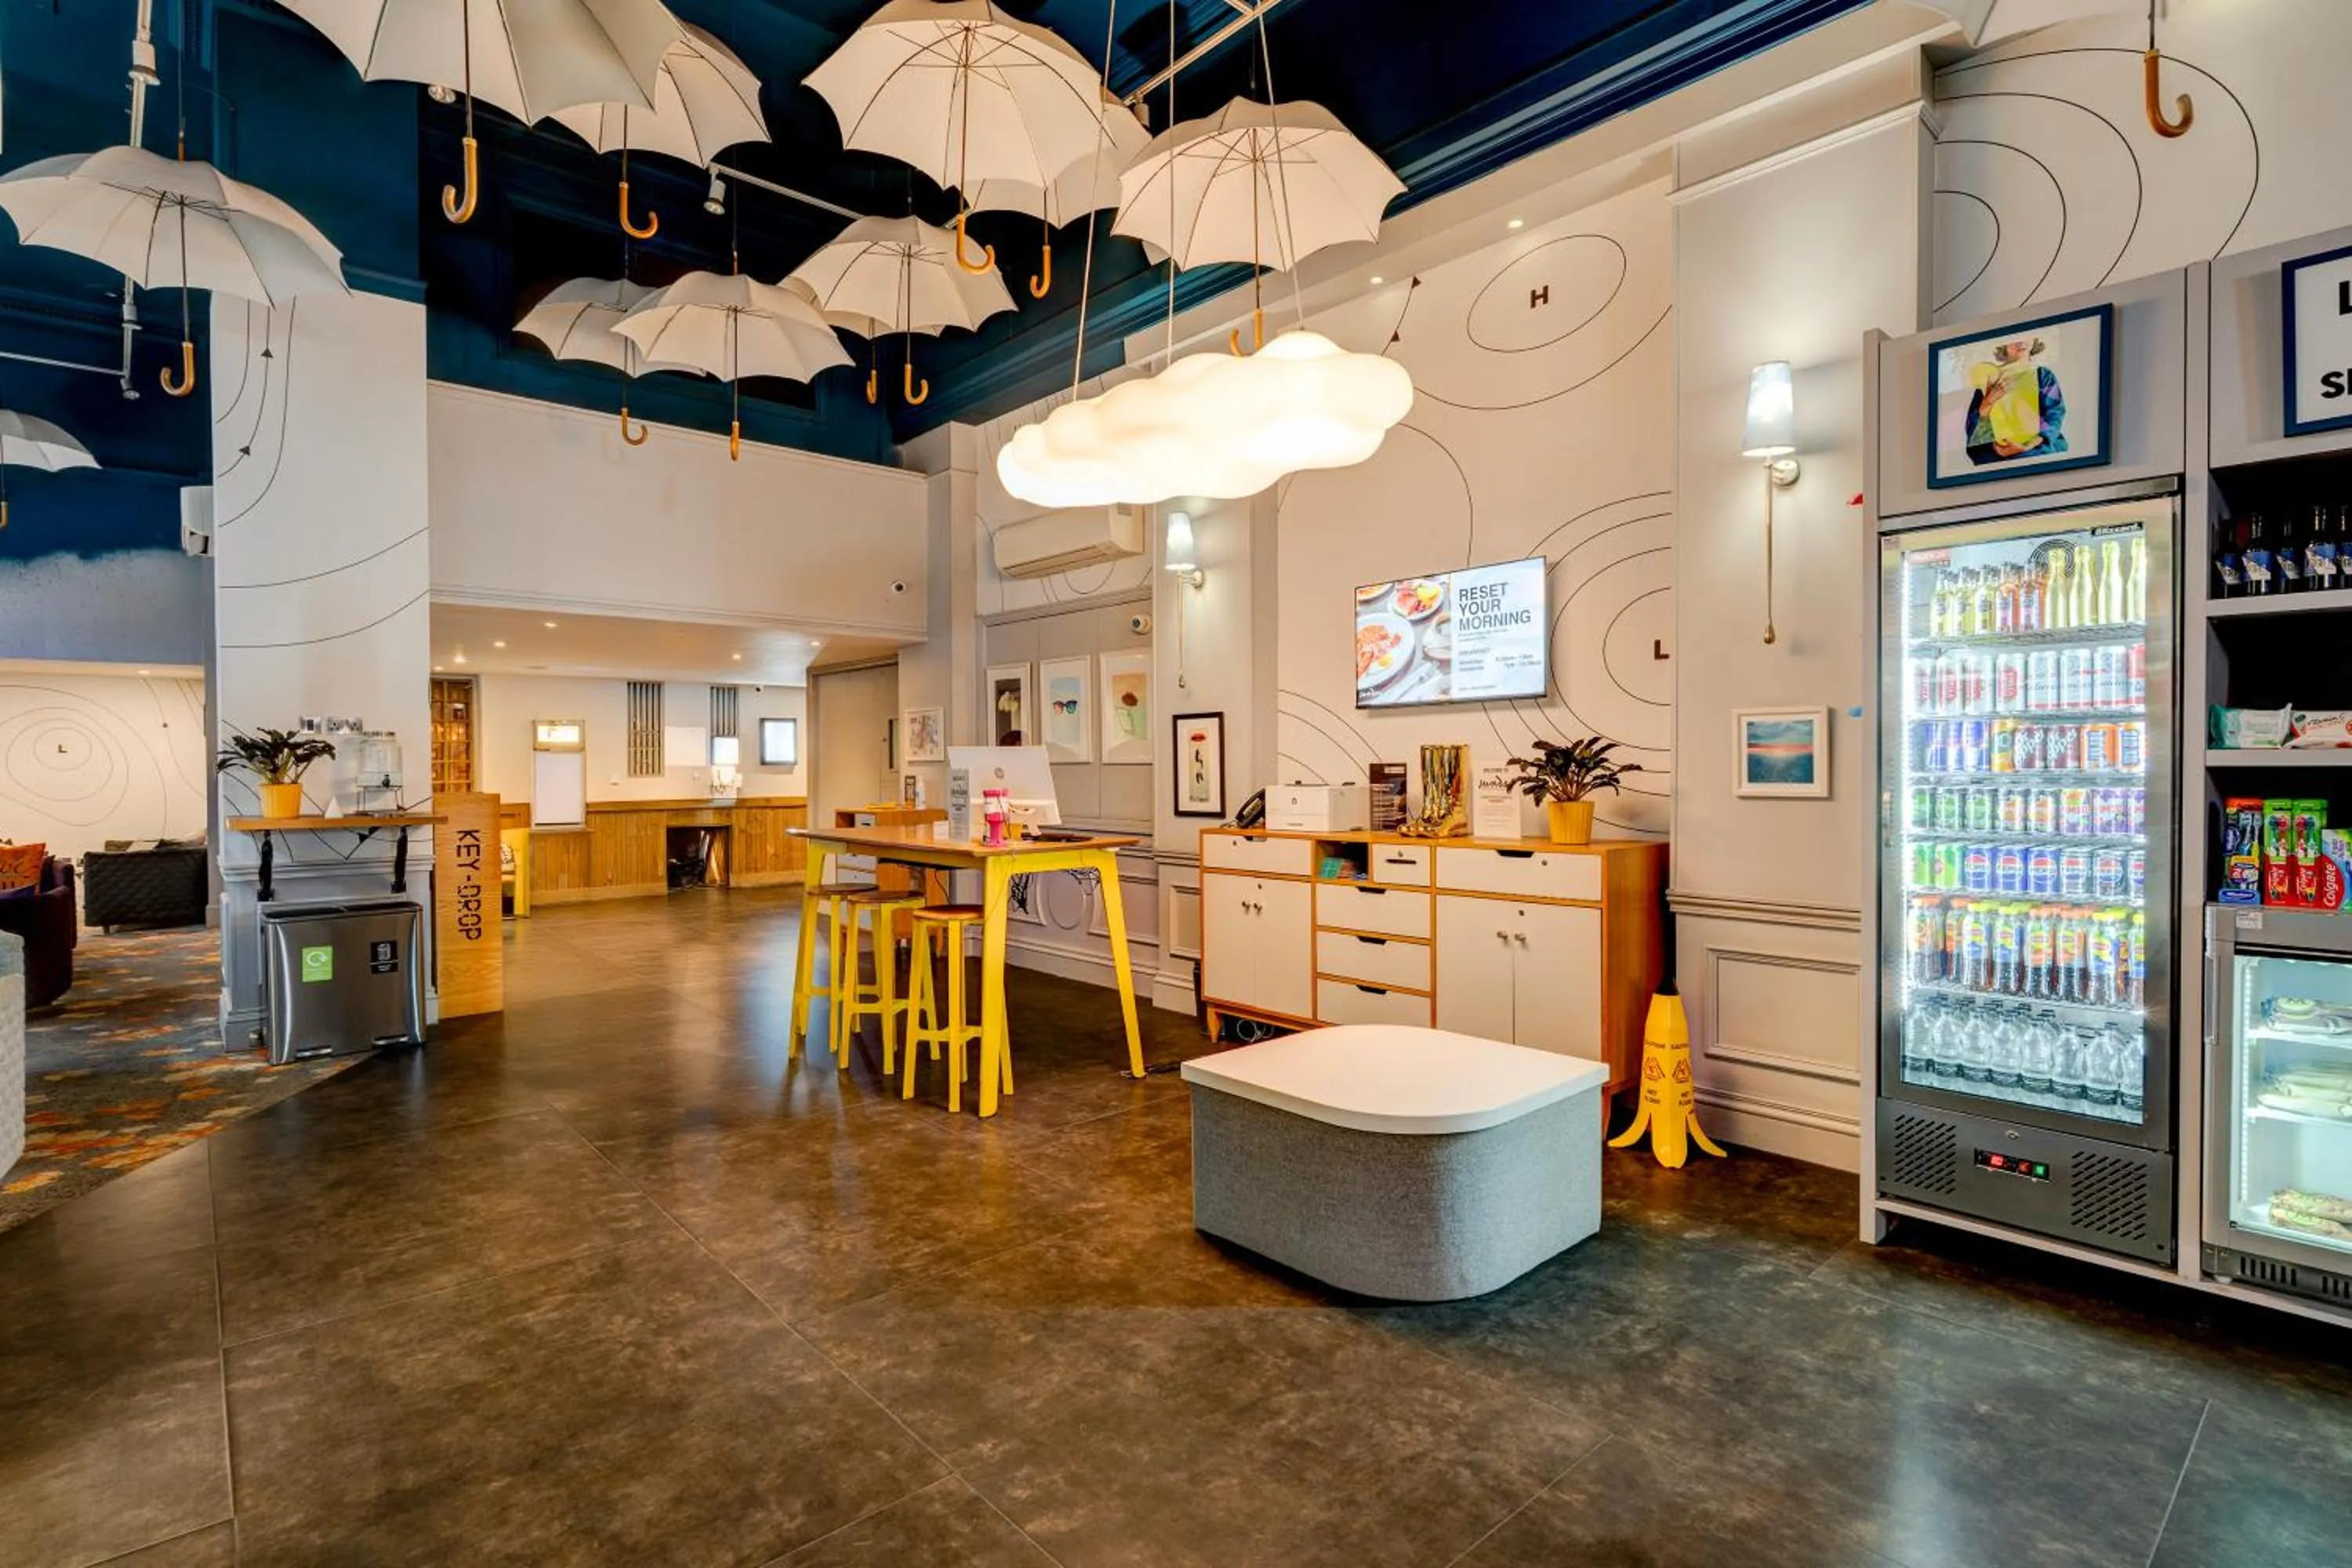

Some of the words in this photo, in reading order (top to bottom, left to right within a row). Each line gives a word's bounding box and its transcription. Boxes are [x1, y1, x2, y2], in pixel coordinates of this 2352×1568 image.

[1530, 285, 1548, 309] H
[1459, 582, 1508, 601] RESET
[1459, 598, 1501, 616] YOUR
[1459, 609, 1531, 630] MORNING
[1654, 639, 1669, 660] L
[58, 744, 68, 753] L
[456, 829, 482, 940] KEY-DROP
[2323, 863, 2339, 906] Colgate
